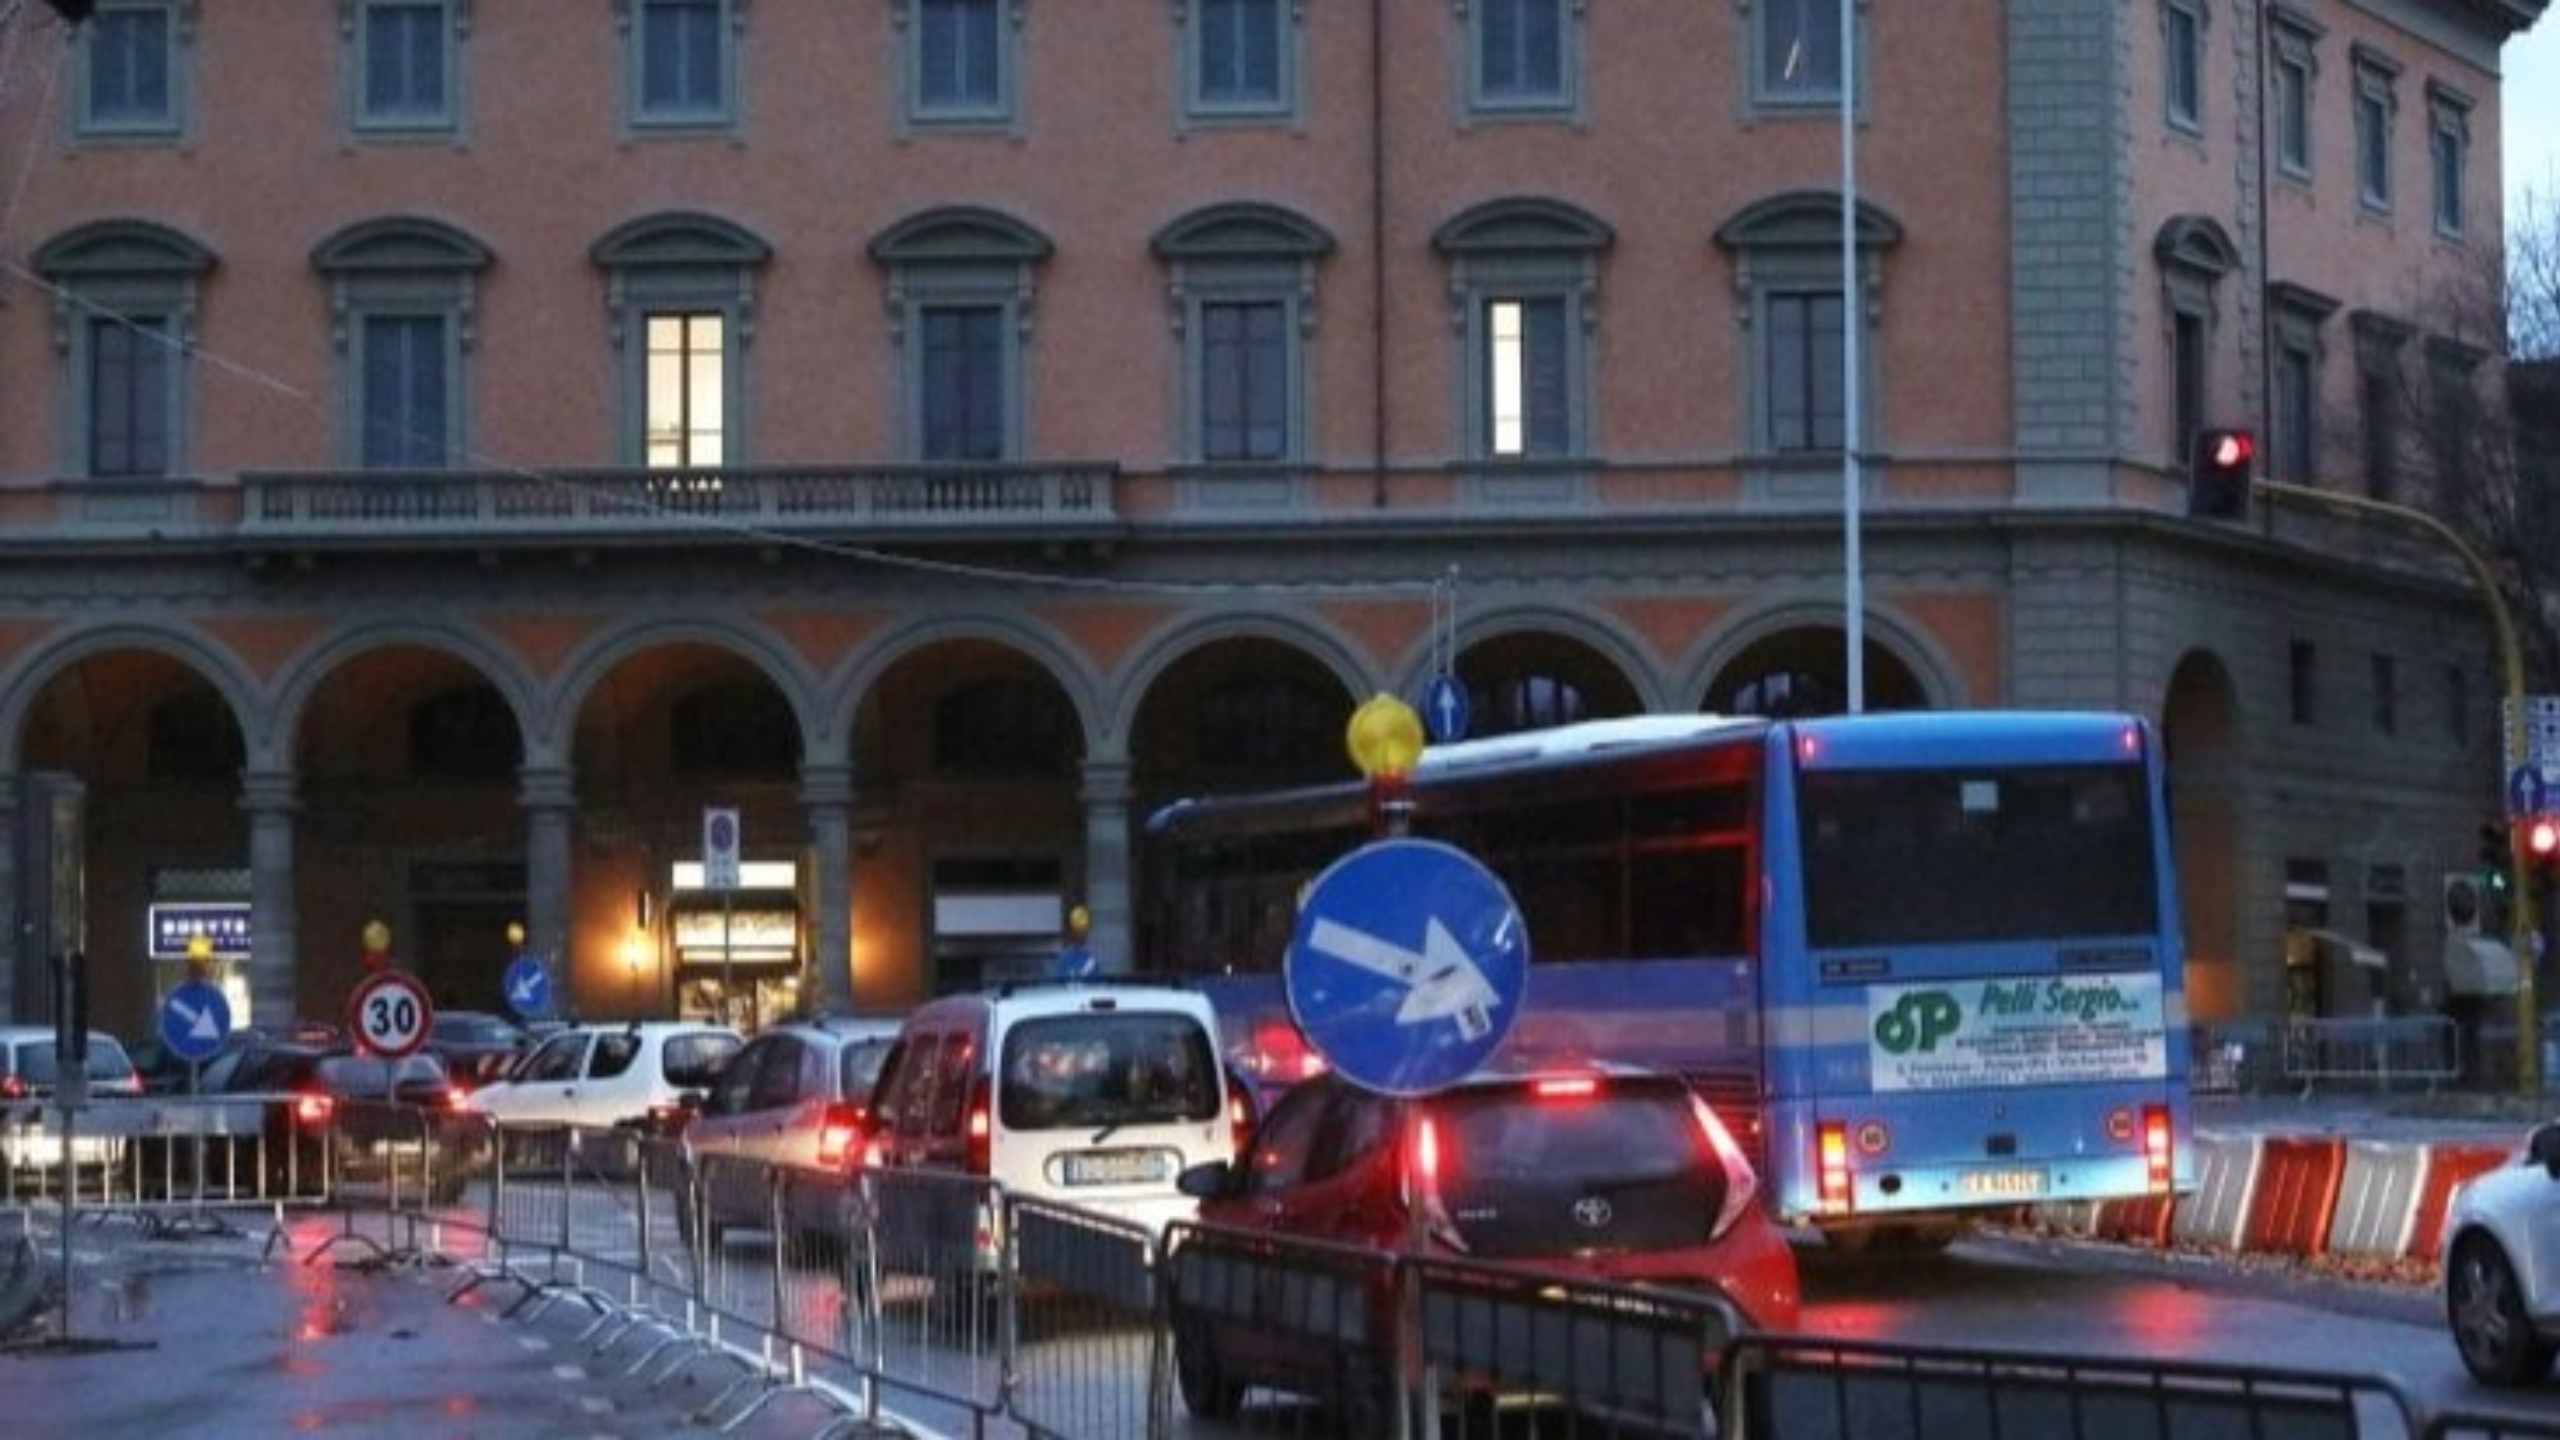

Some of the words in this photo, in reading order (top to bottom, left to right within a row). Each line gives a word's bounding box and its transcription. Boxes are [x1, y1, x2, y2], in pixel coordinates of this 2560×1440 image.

[369, 997, 414, 1036] 30
[1981, 978, 2038, 1014] Pelli
[2043, 977, 2121, 1020] Sergio
